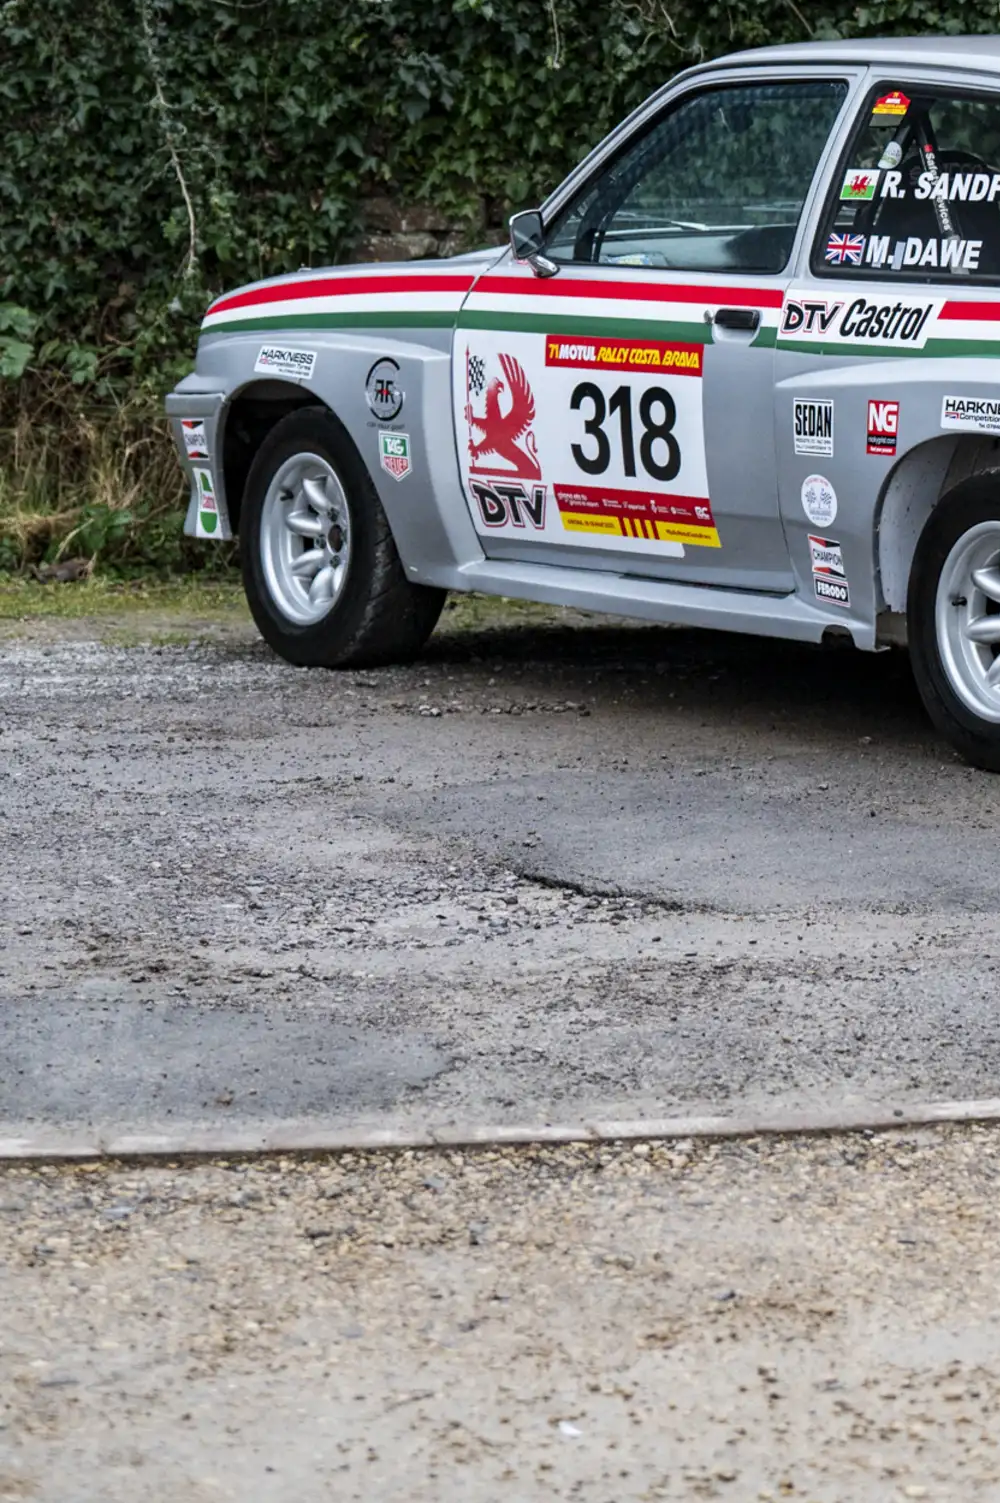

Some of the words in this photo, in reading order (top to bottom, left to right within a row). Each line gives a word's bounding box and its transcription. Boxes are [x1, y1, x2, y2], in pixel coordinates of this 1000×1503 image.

[880, 171, 905, 198] R.
[866, 236, 895, 266] M.
[903, 238, 982, 269] DAWE
[781, 300, 843, 333] DTV
[839, 299, 933, 340] Castrol
[261, 349, 314, 364] HARKNESS
[559, 344, 596, 361] MOTUL
[597, 346, 629, 364] RALLY
[629, 348, 660, 365] COSTA
[661, 350, 700, 368] BRAVA
[570, 382, 681, 481] 318
[795, 404, 832, 438] SEDAN
[868, 403, 898, 433] NG
[385, 439, 404, 455] TAG
[384, 456, 408, 475] HEUER
[468, 477, 547, 530] DTV
[812, 548, 843, 567] CHAMPION
[817, 581, 846, 600] FERODO
